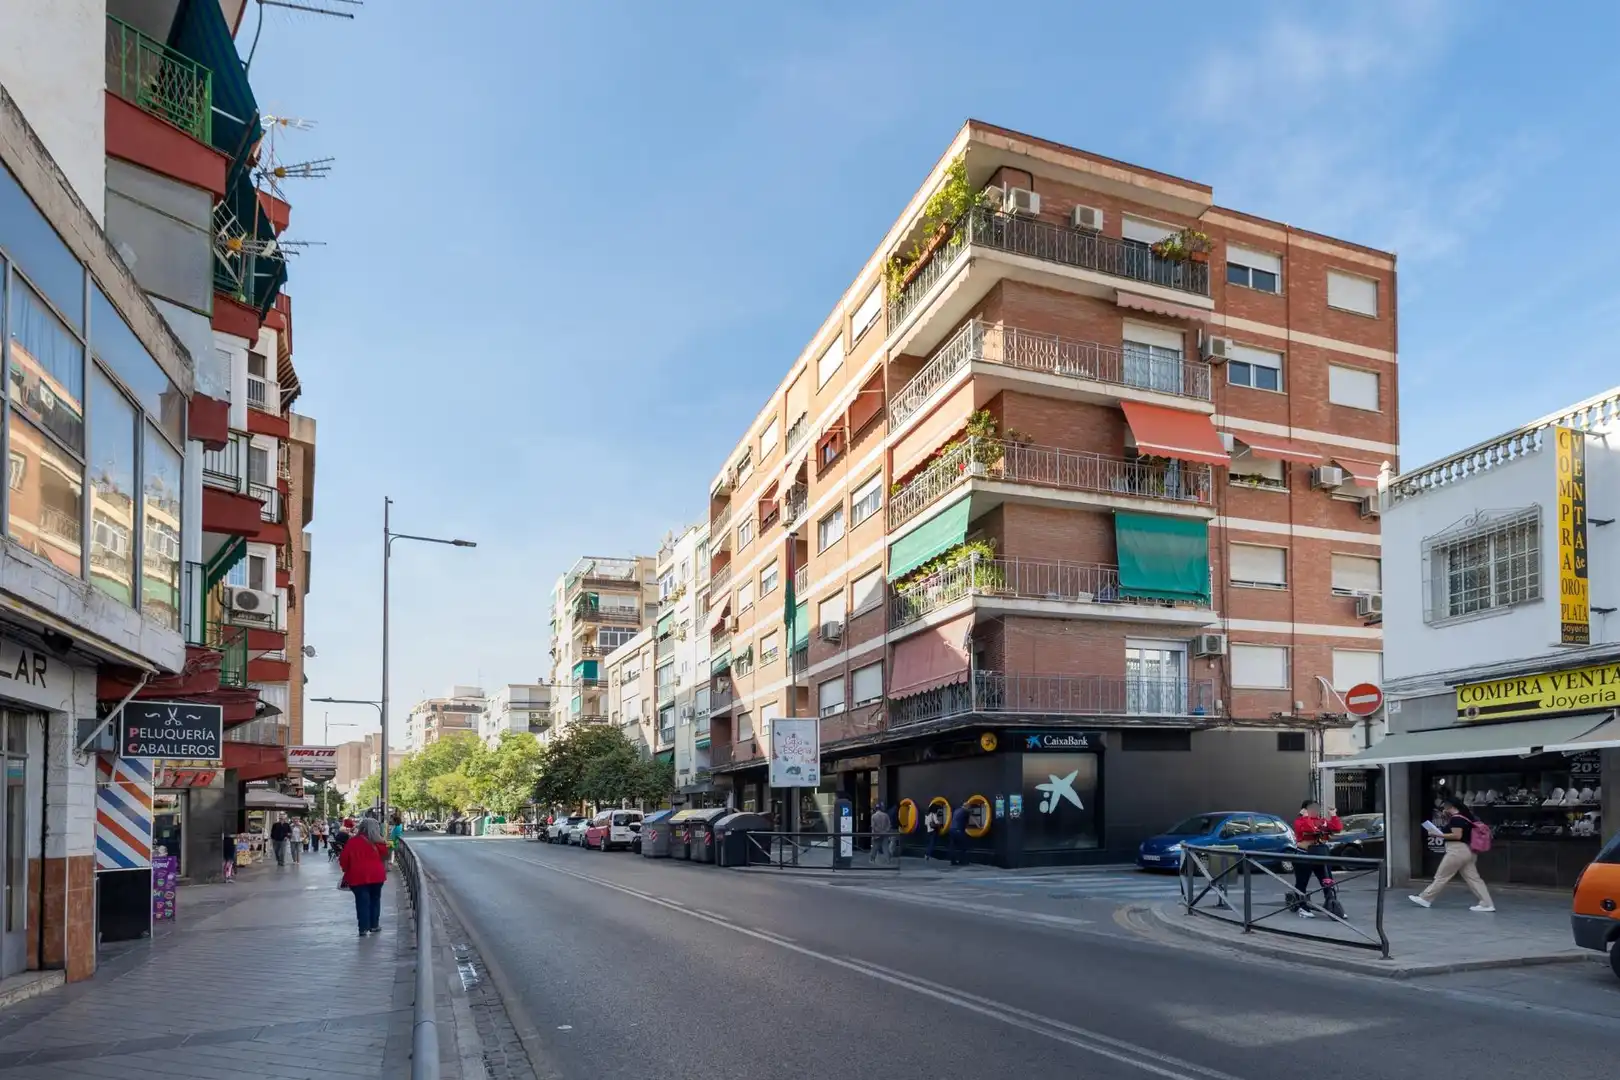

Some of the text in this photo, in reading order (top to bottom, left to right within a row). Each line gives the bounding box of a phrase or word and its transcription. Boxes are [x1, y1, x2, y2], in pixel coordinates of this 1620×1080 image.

[1561, 579, 1580, 595] ORO
[1560, 603, 1588, 621] PLATA
[1460, 667, 1620, 703] COMPRA VENTA
[1546, 688, 1616, 709] Joyería
[129, 727, 215, 740] PELUQUERÍA
[1043, 735, 1088, 746] CaixaBank
[128, 743, 215, 755] CABALLEROS
[289, 749, 336, 757] IMPACTO
[842, 807, 850, 816] P
